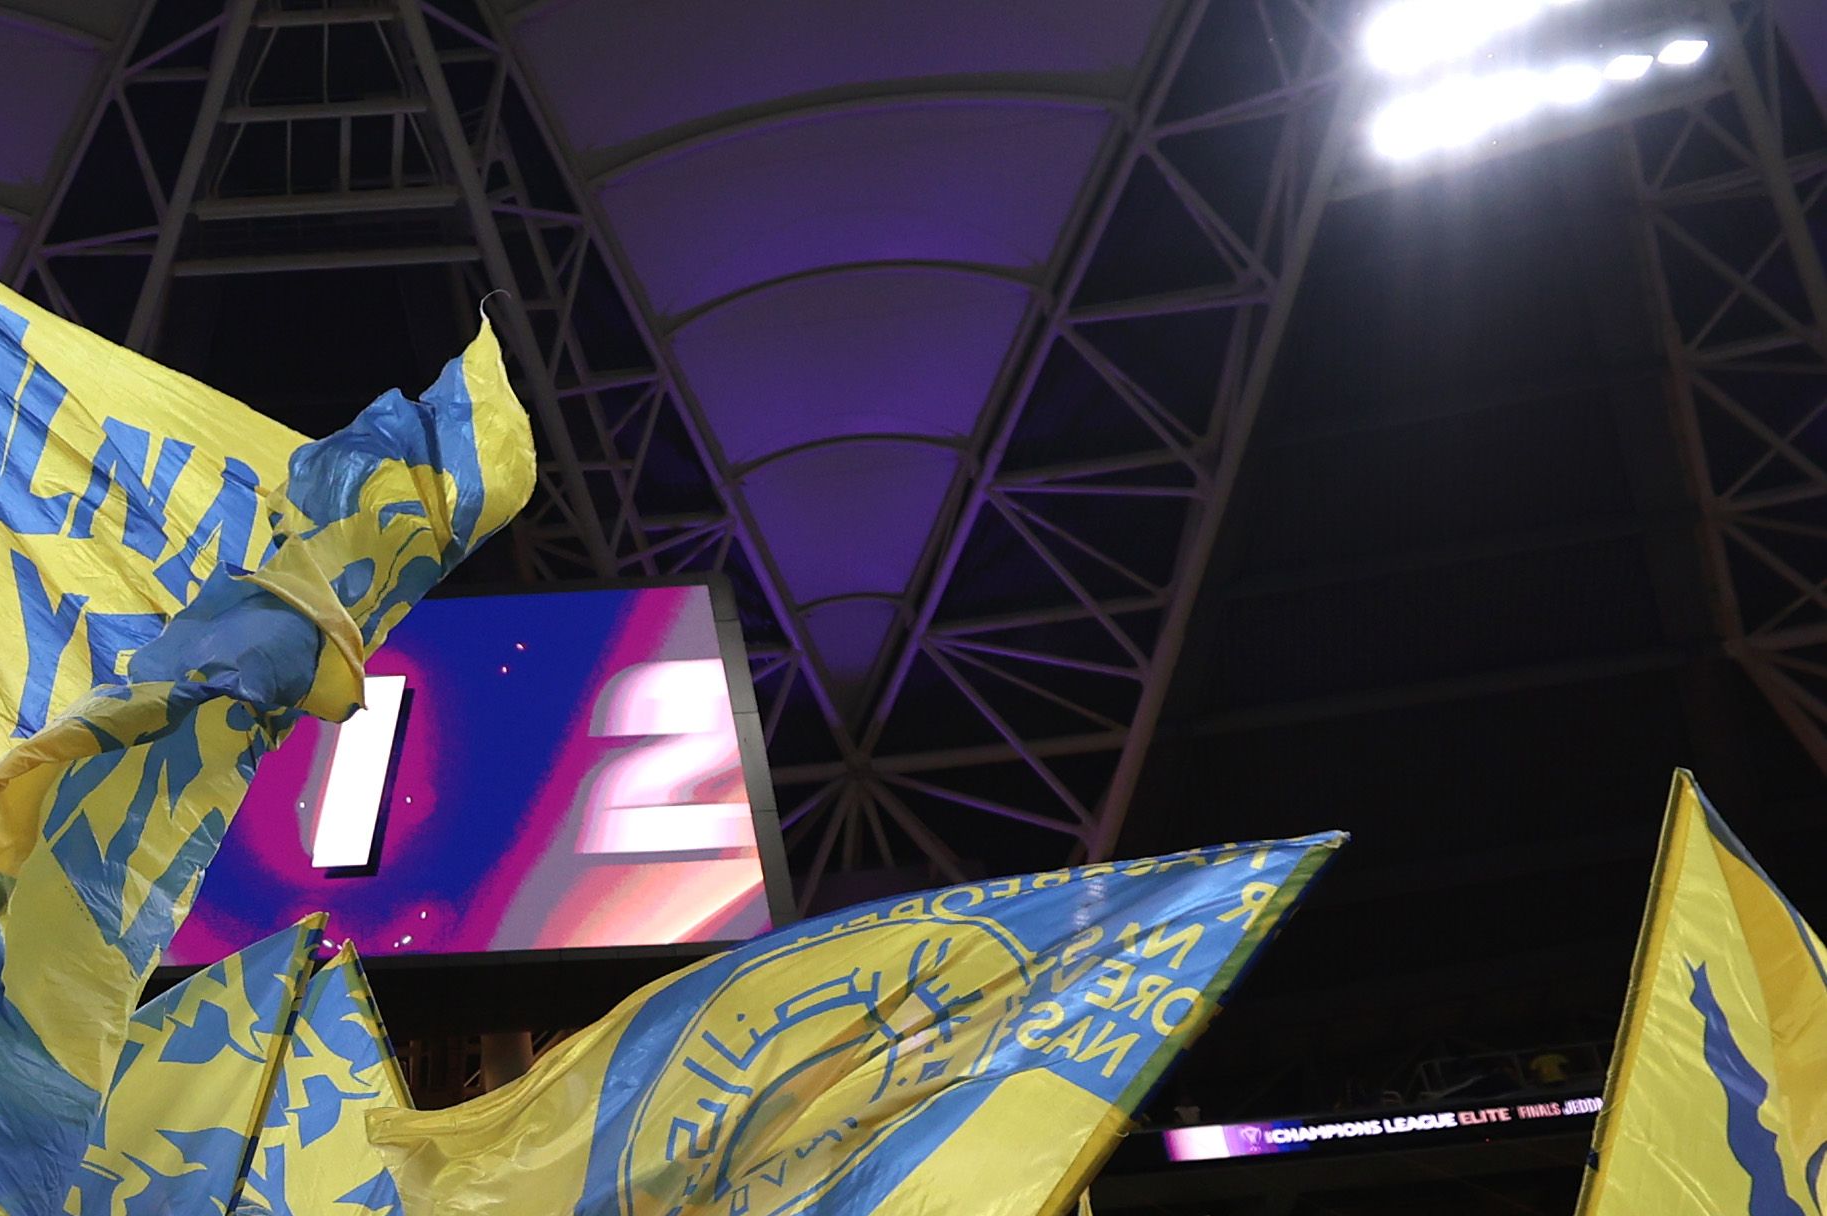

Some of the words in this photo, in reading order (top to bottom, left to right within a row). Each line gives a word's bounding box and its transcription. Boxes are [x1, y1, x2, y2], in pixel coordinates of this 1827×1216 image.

[1273, 1119, 1383, 1144] CHAMPIONS
[1383, 1111, 1459, 1134] LEAGUE
[1458, 1107, 1512, 1126] ELITE
[1517, 1101, 1562, 1120] FINALS
[1562, 1096, 1604, 1116] JEDD
